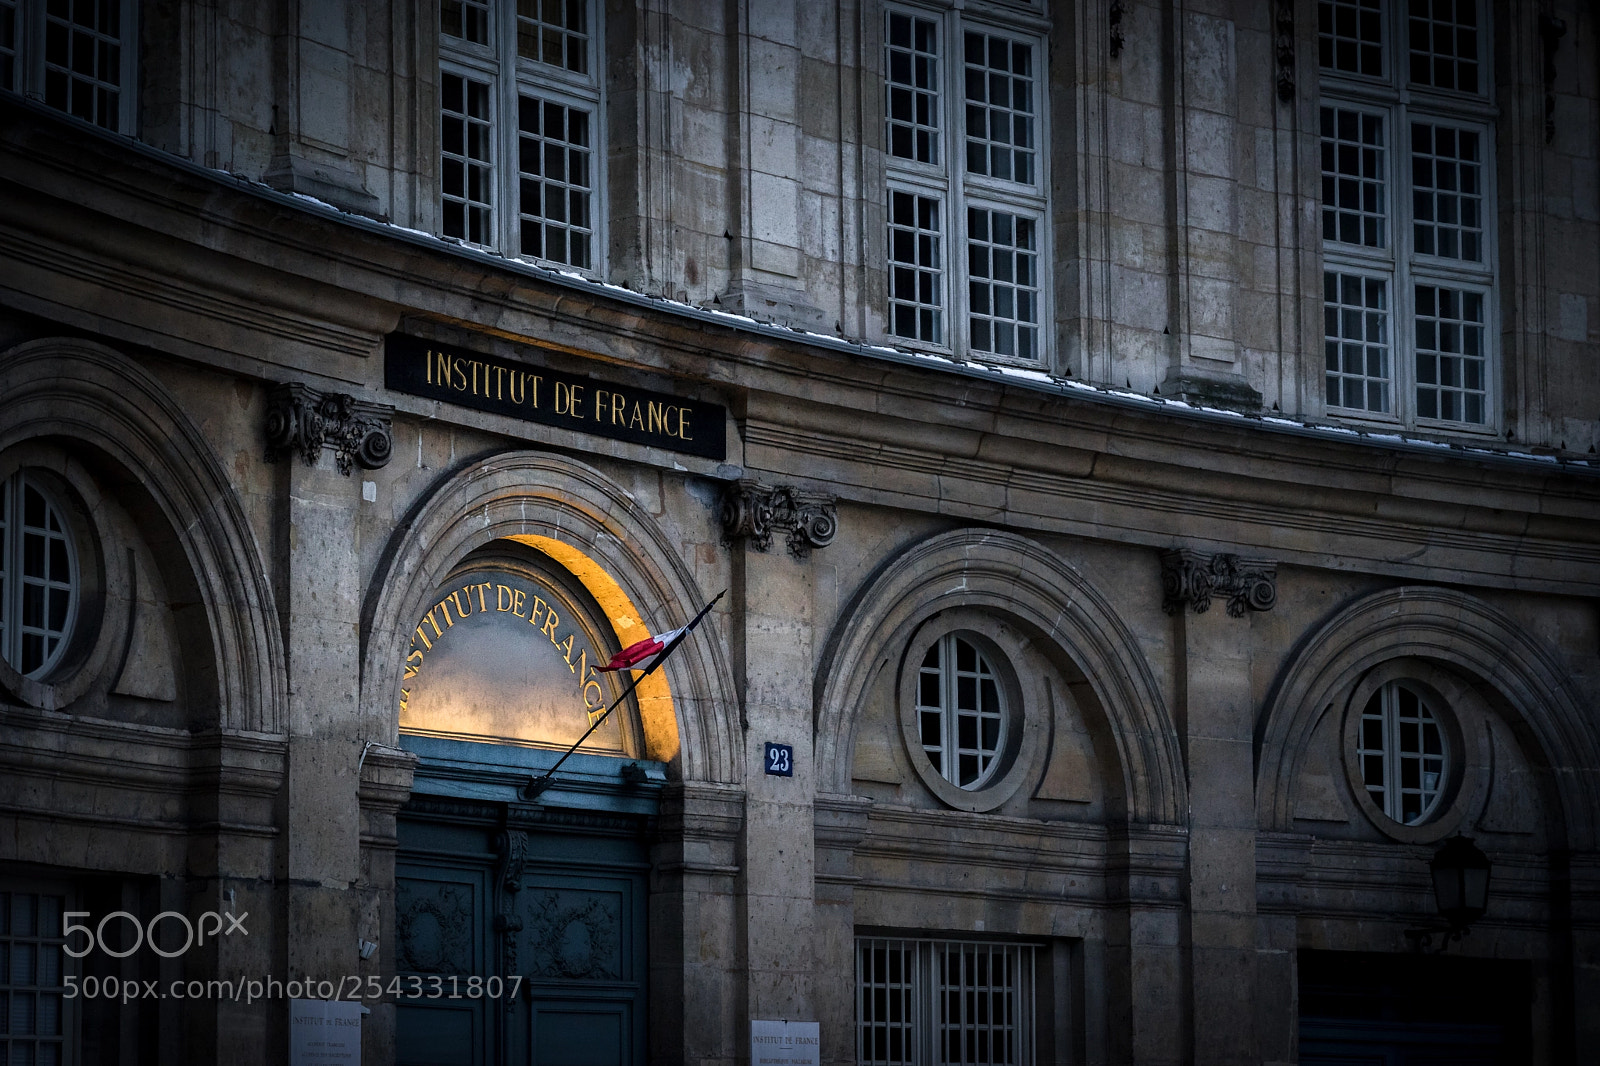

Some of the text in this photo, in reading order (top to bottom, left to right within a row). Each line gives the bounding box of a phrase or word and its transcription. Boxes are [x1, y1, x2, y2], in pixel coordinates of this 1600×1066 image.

[426, 350, 693, 440] INSTITUT DE FRANCE
[497, 584, 526, 618] DE
[529, 595, 609, 733] FRANCE
[770, 748, 789, 771] 23
[753, 1036, 783, 1045] INSTITUT
[795, 1036, 819, 1046] FRANCE
